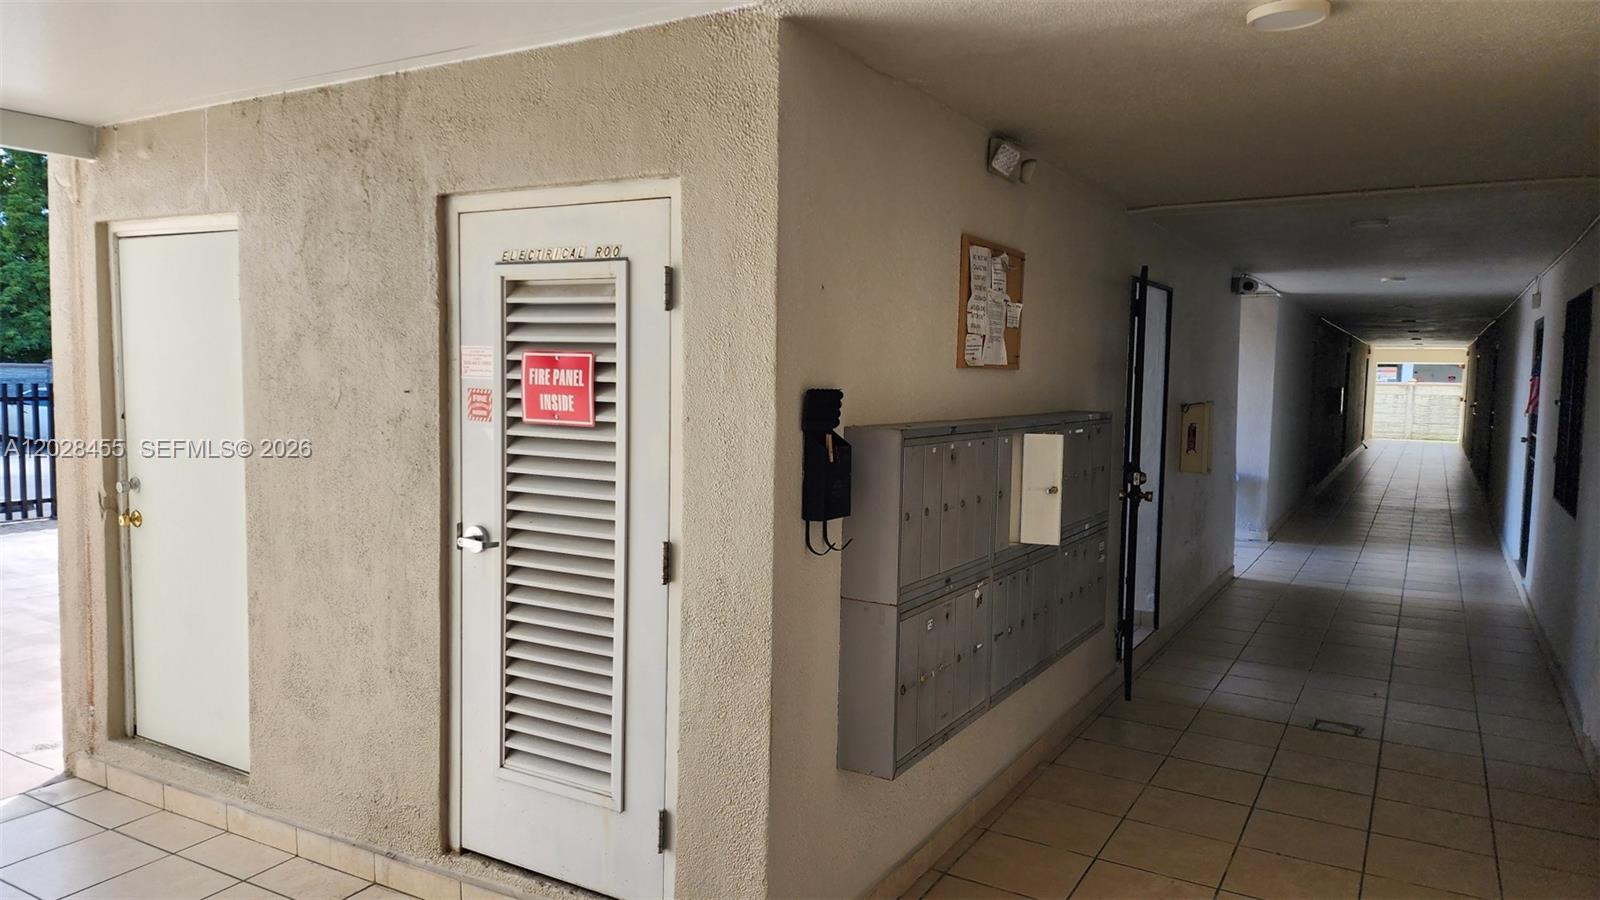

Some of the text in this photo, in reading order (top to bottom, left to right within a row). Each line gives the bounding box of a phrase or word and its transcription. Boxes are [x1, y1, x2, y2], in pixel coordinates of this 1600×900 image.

[502, 245, 621, 262] ELECTRICAL ROO
[529, 368, 584, 387] FIRE PANEL
[540, 393, 575, 412] INSIDE
